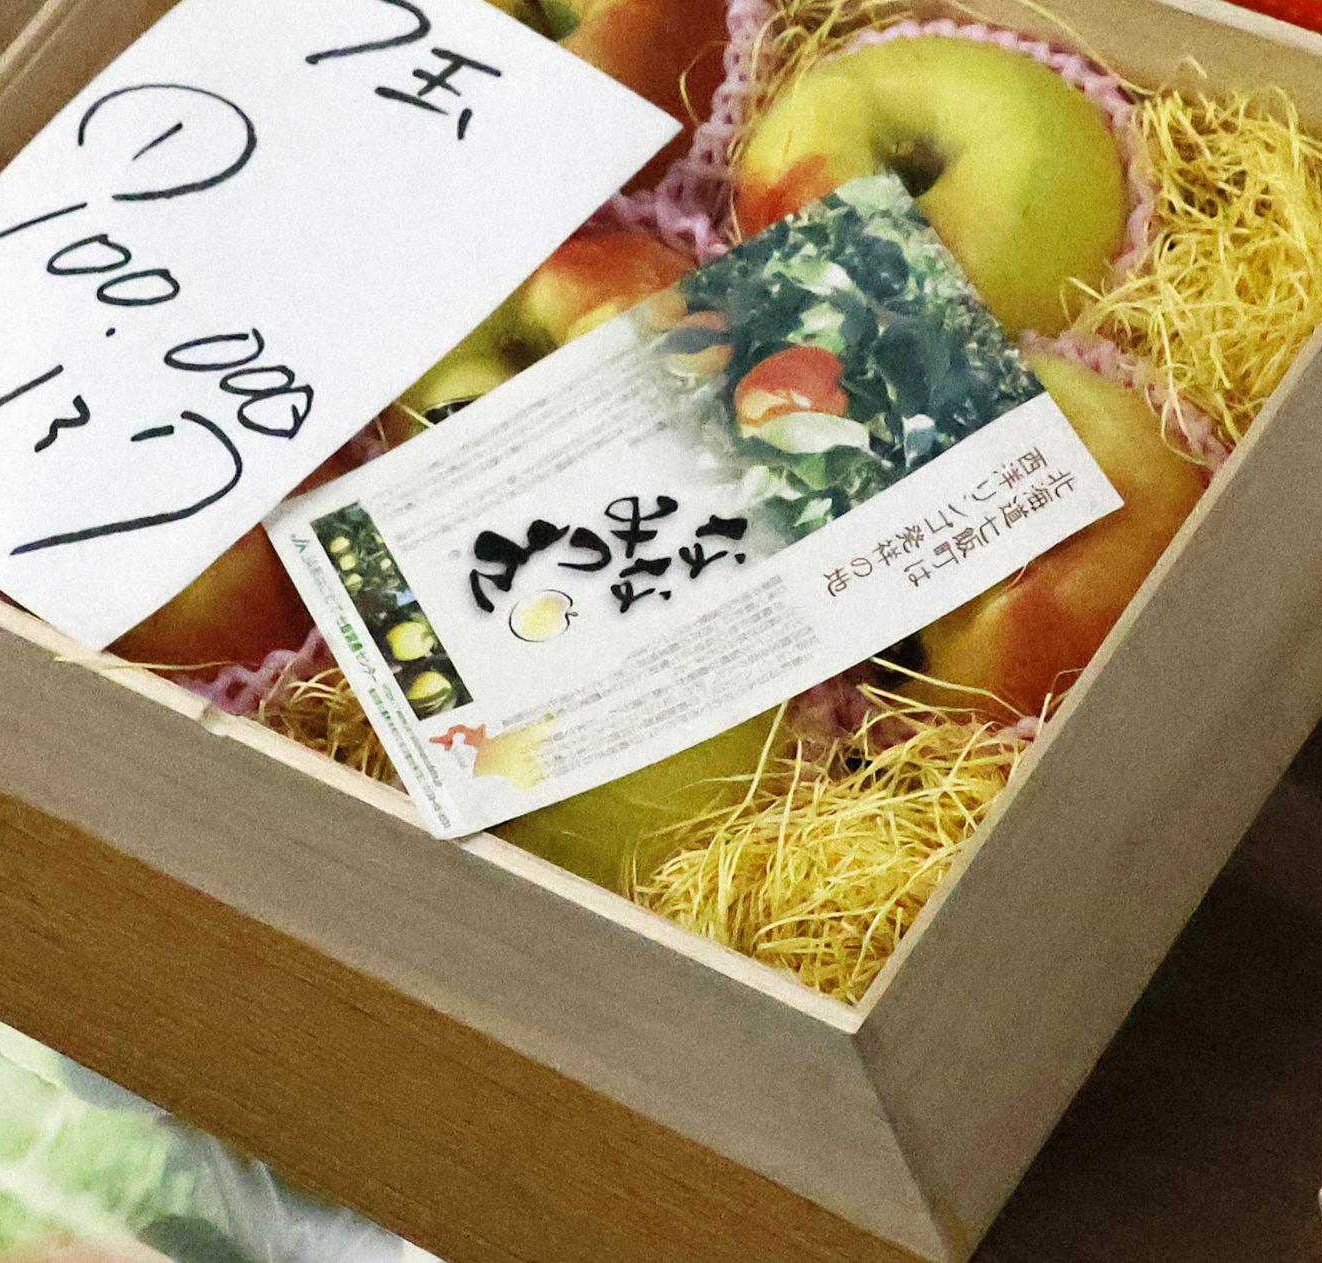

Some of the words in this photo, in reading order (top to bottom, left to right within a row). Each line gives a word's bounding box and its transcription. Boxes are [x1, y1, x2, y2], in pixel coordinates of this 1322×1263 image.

[469, 495, 748, 613] ななみつき
[823, 447, 1048, 597] 西洋リンゴ発祥の地
[903, 469, 1076, 587] 北海道七飯町は
